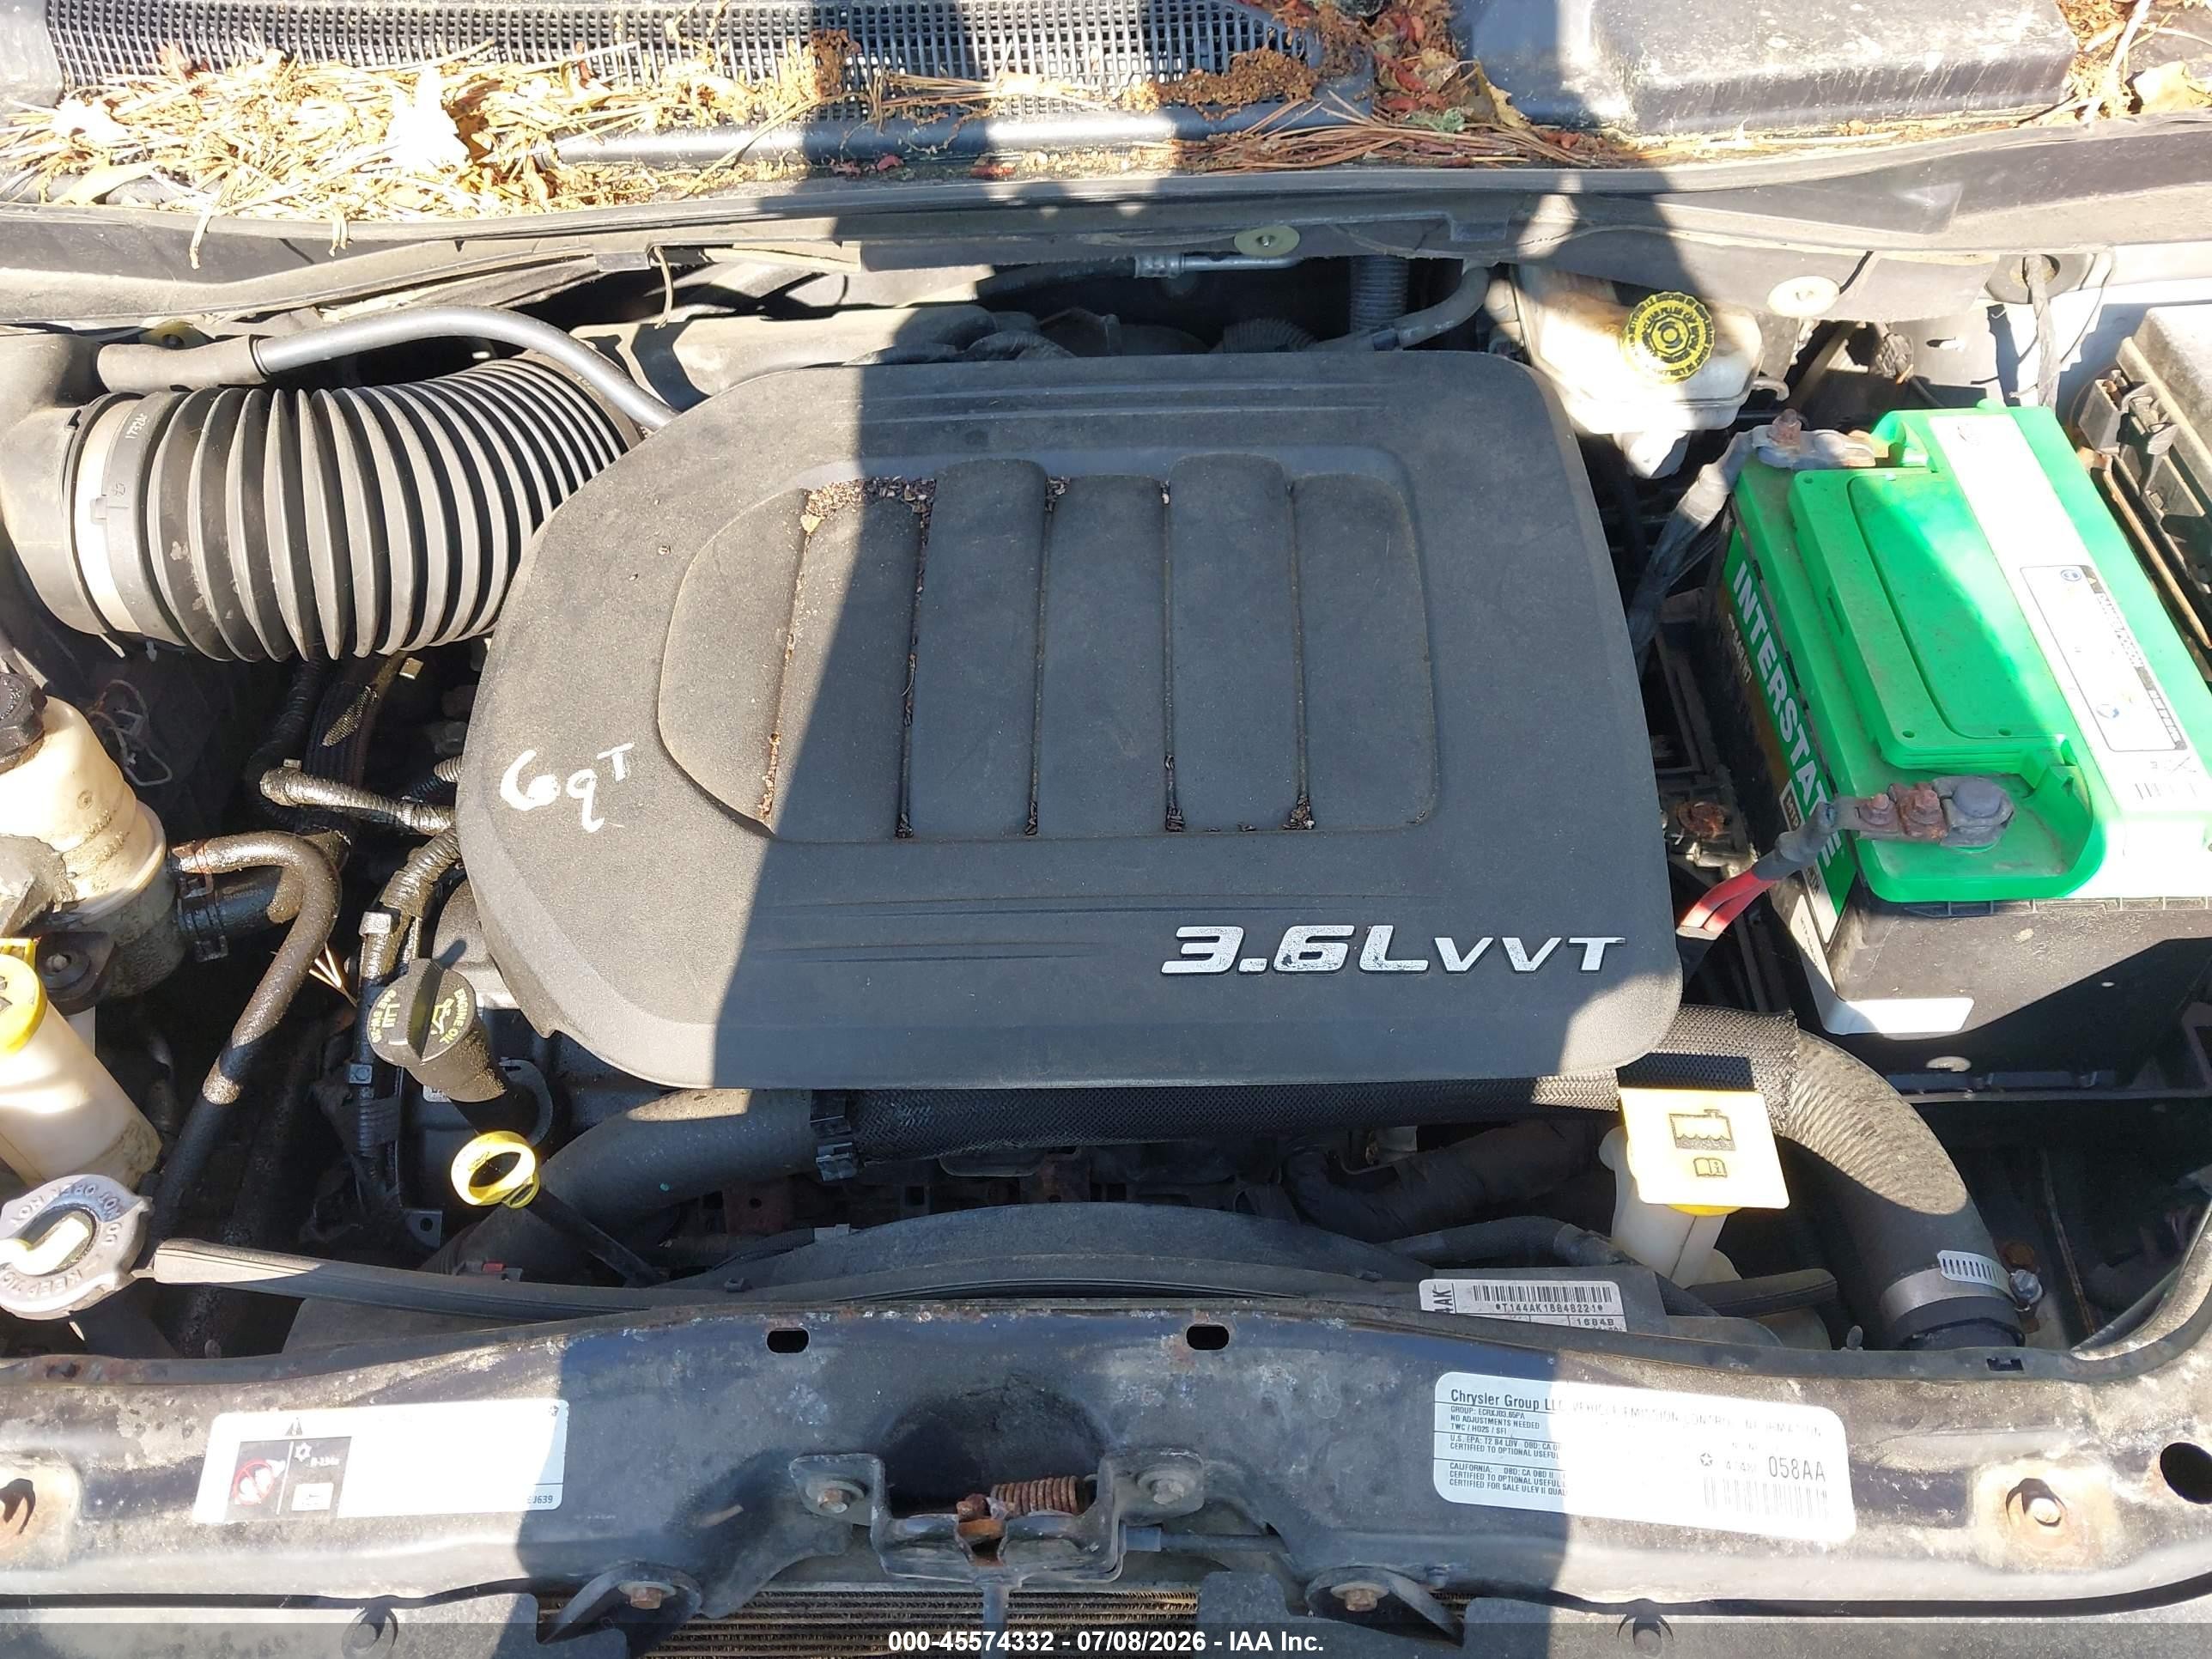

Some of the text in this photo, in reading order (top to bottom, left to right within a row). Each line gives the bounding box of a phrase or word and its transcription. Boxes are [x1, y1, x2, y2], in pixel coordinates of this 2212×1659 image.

[1160, 925, 1626, 975] 3.6L VVT
[439, 988, 469, 1045] ENGINE OIL
[370, 1011, 383, 1043] 5W-20
[27, 1269, 82, 1298] KEEP
[1450, 1389, 1500, 1406] Chrysler
[1504, 1395, 1540, 1412] Group
[1450, 1406, 1477, 1414] GROUP:
[1451, 1423, 1466, 1431] TWC
[1462, 1415, 1511, 1427] ADJUSTMENTS
[1513, 1419, 1540, 1430] NEEDED
[1449, 1434, 1465, 1443] U.S.
[1466, 1436, 1483, 1444] EPA:
[1541, 1442, 1552, 1451] CA
[1449, 1442, 1486, 1452] CERTIFIED
[1487, 1444, 1497, 1453] TO
[1498, 1445, 1532, 1456] OPTIONAL
[1449, 1462, 1493, 1474] CALIFORNIA:
[1522, 1468, 1532, 1477] CA
[1533, 1469, 1547, 1478] OBD
[1768, 1455, 1826, 1483] 058AA
[1449, 1470, 1560, 1488] CERTIFIED TO OPTIONAL USEFUL
[1449, 1478, 1485, 1489] CERTIFIED
[1486, 1481, 1501, 1491] FOR
[1502, 1482, 1519, 1493] SALE
[1521, 1484, 1540, 1494] ULEV
